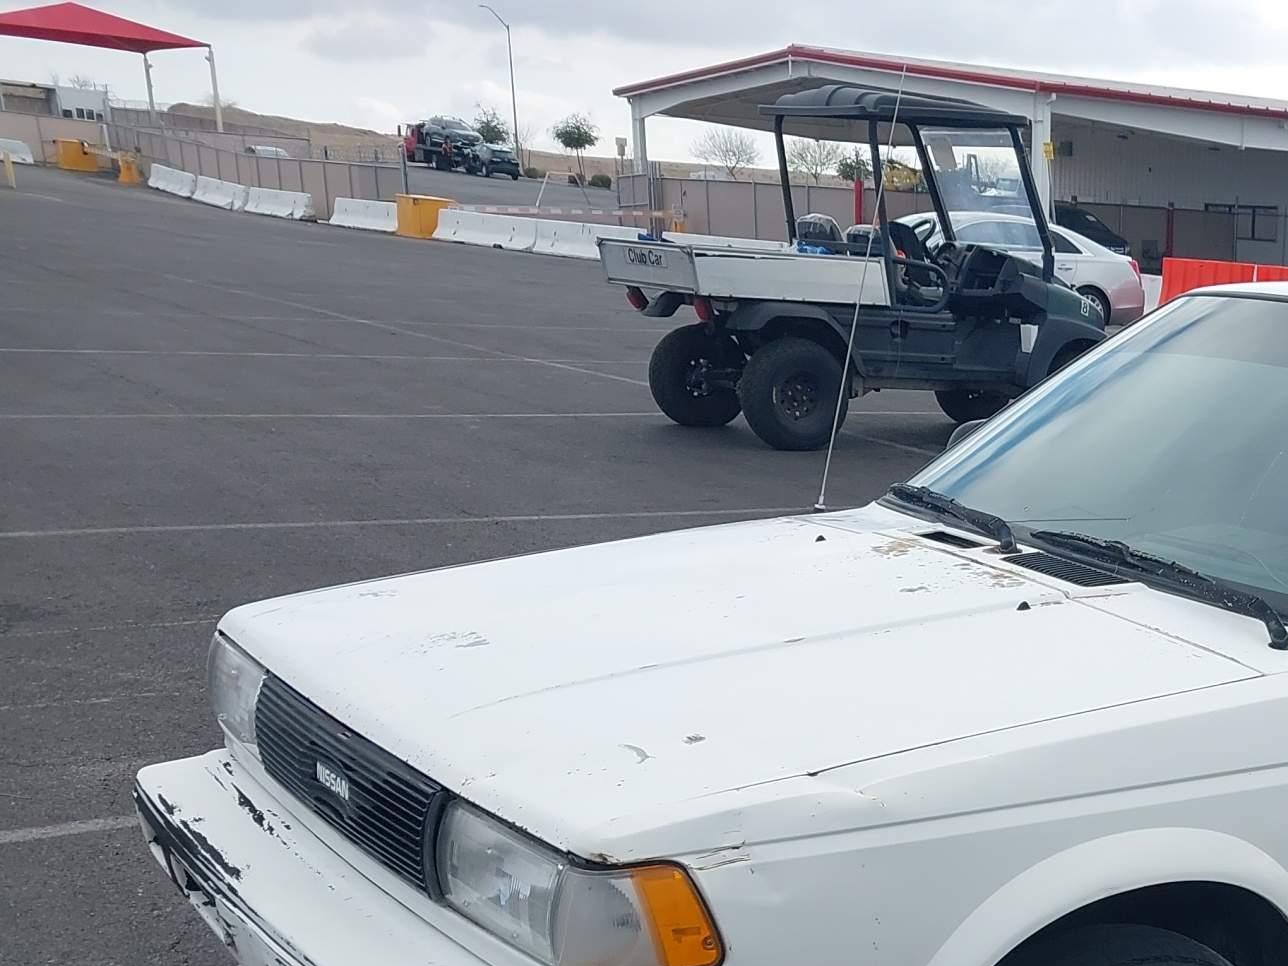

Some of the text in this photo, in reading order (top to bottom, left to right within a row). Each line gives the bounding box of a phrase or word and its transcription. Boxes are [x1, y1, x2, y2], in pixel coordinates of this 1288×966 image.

[627, 247, 663, 265] Club Car
[1082, 302, 1088, 314] 8
[316, 760, 349, 801] NISSAN
